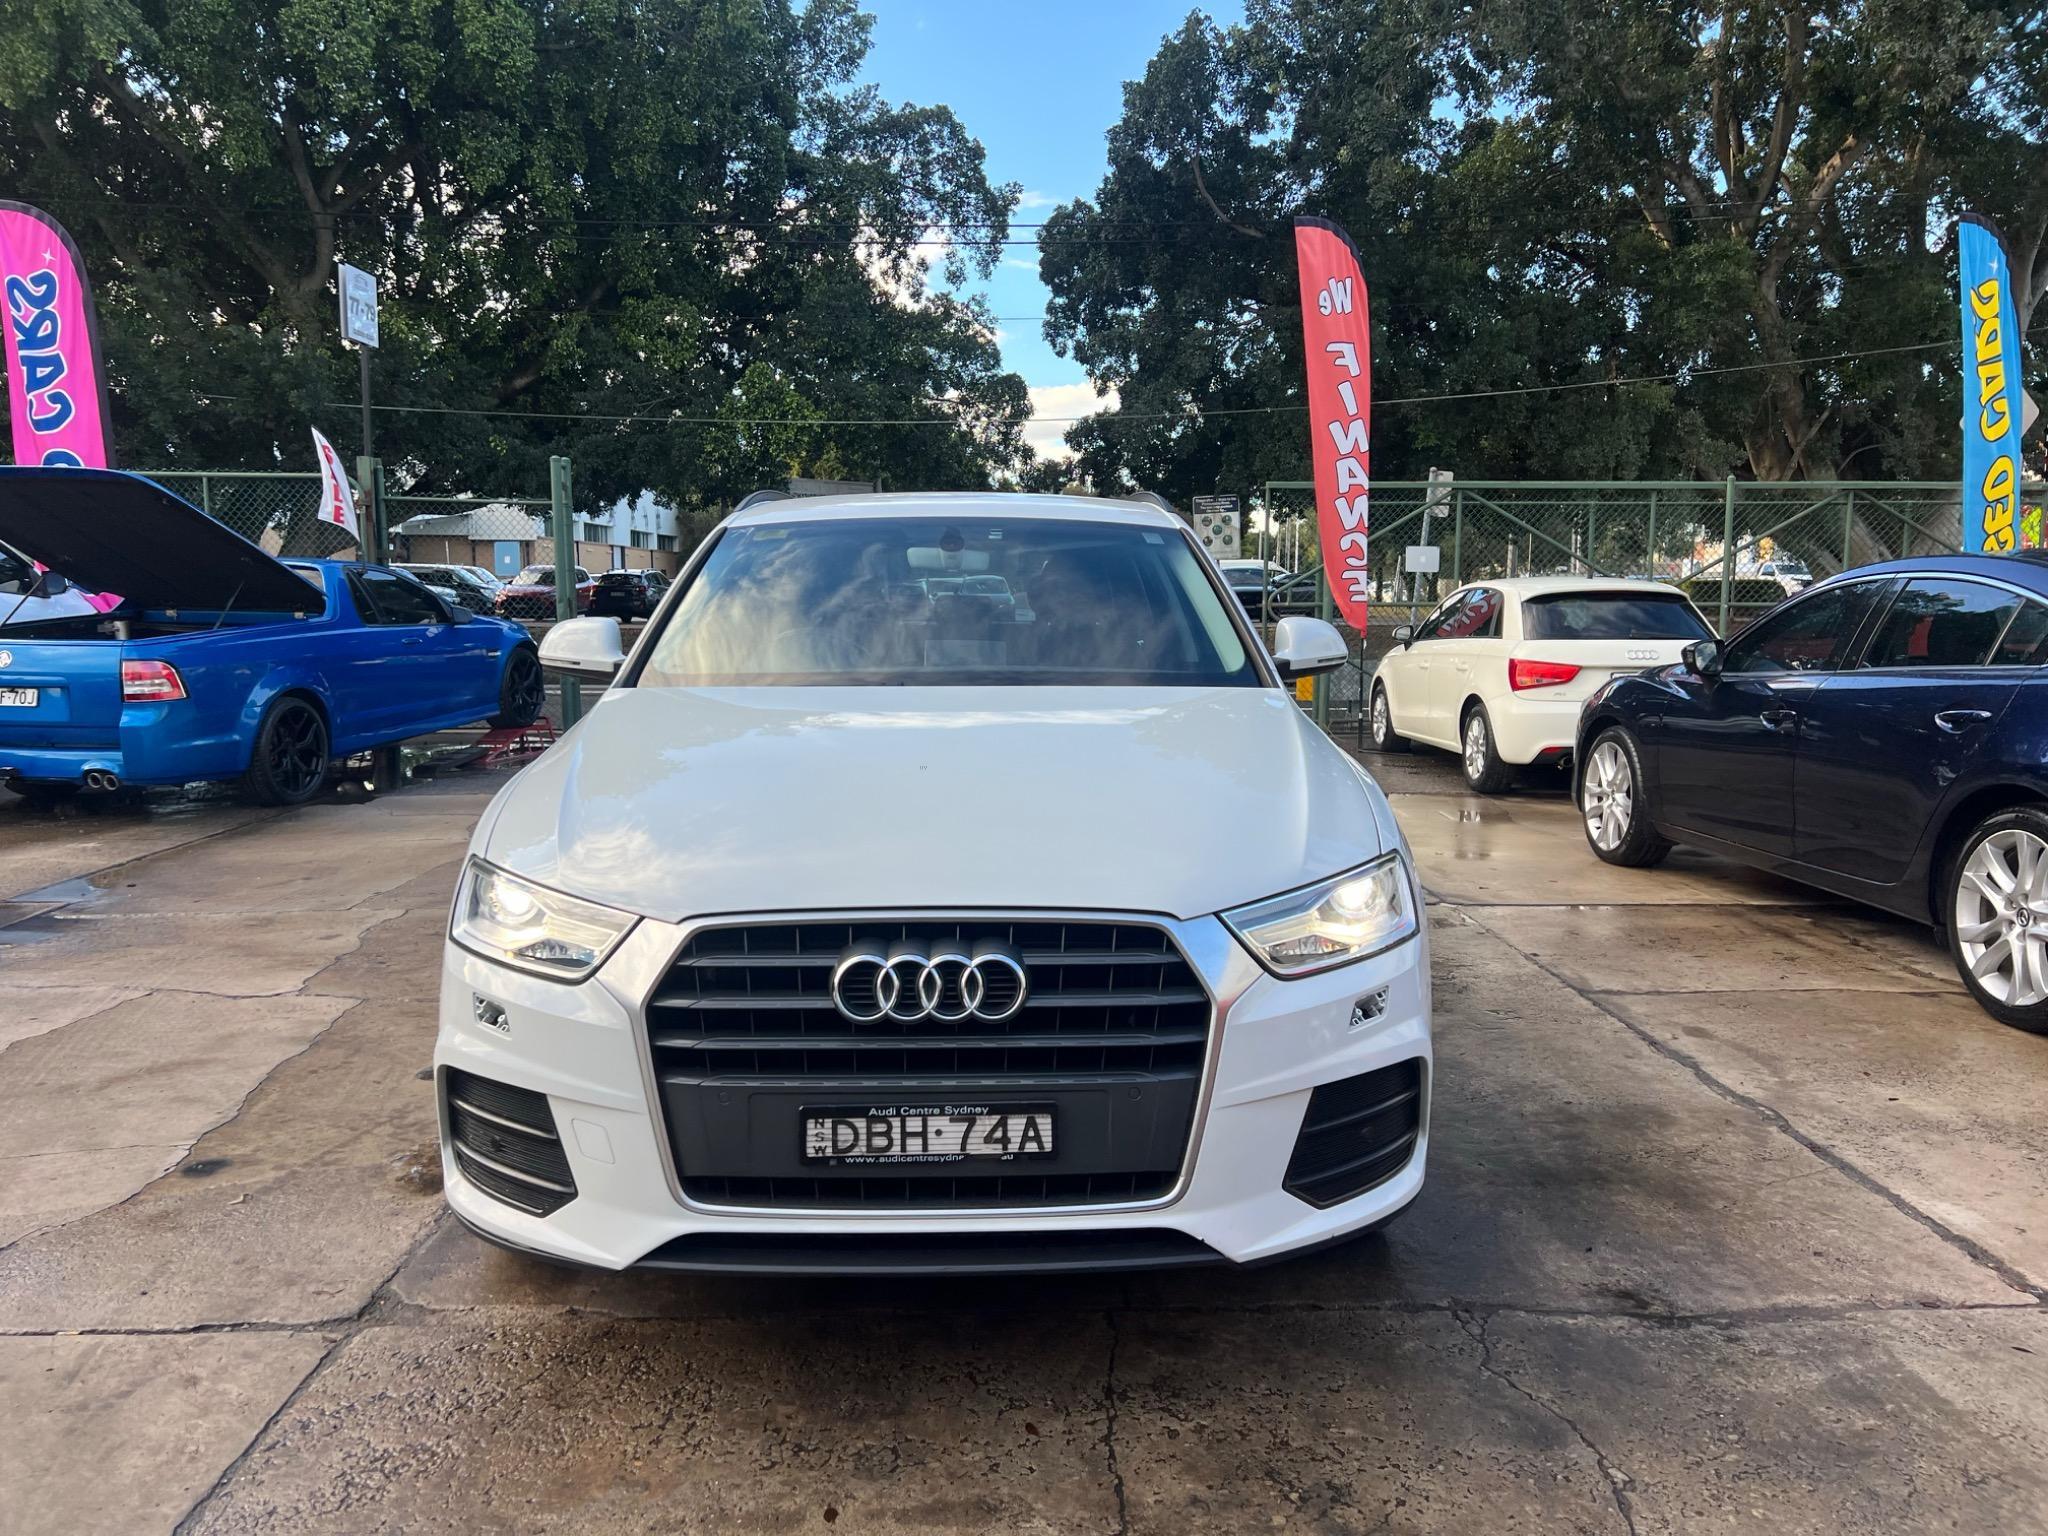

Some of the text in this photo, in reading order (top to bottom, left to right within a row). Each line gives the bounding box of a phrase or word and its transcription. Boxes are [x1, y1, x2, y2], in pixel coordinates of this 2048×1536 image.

[349, 295, 376, 323] 77-79
[321, 443, 345, 525] SLE
[868, 1104, 989, 1116] Audi Centre Sydney
